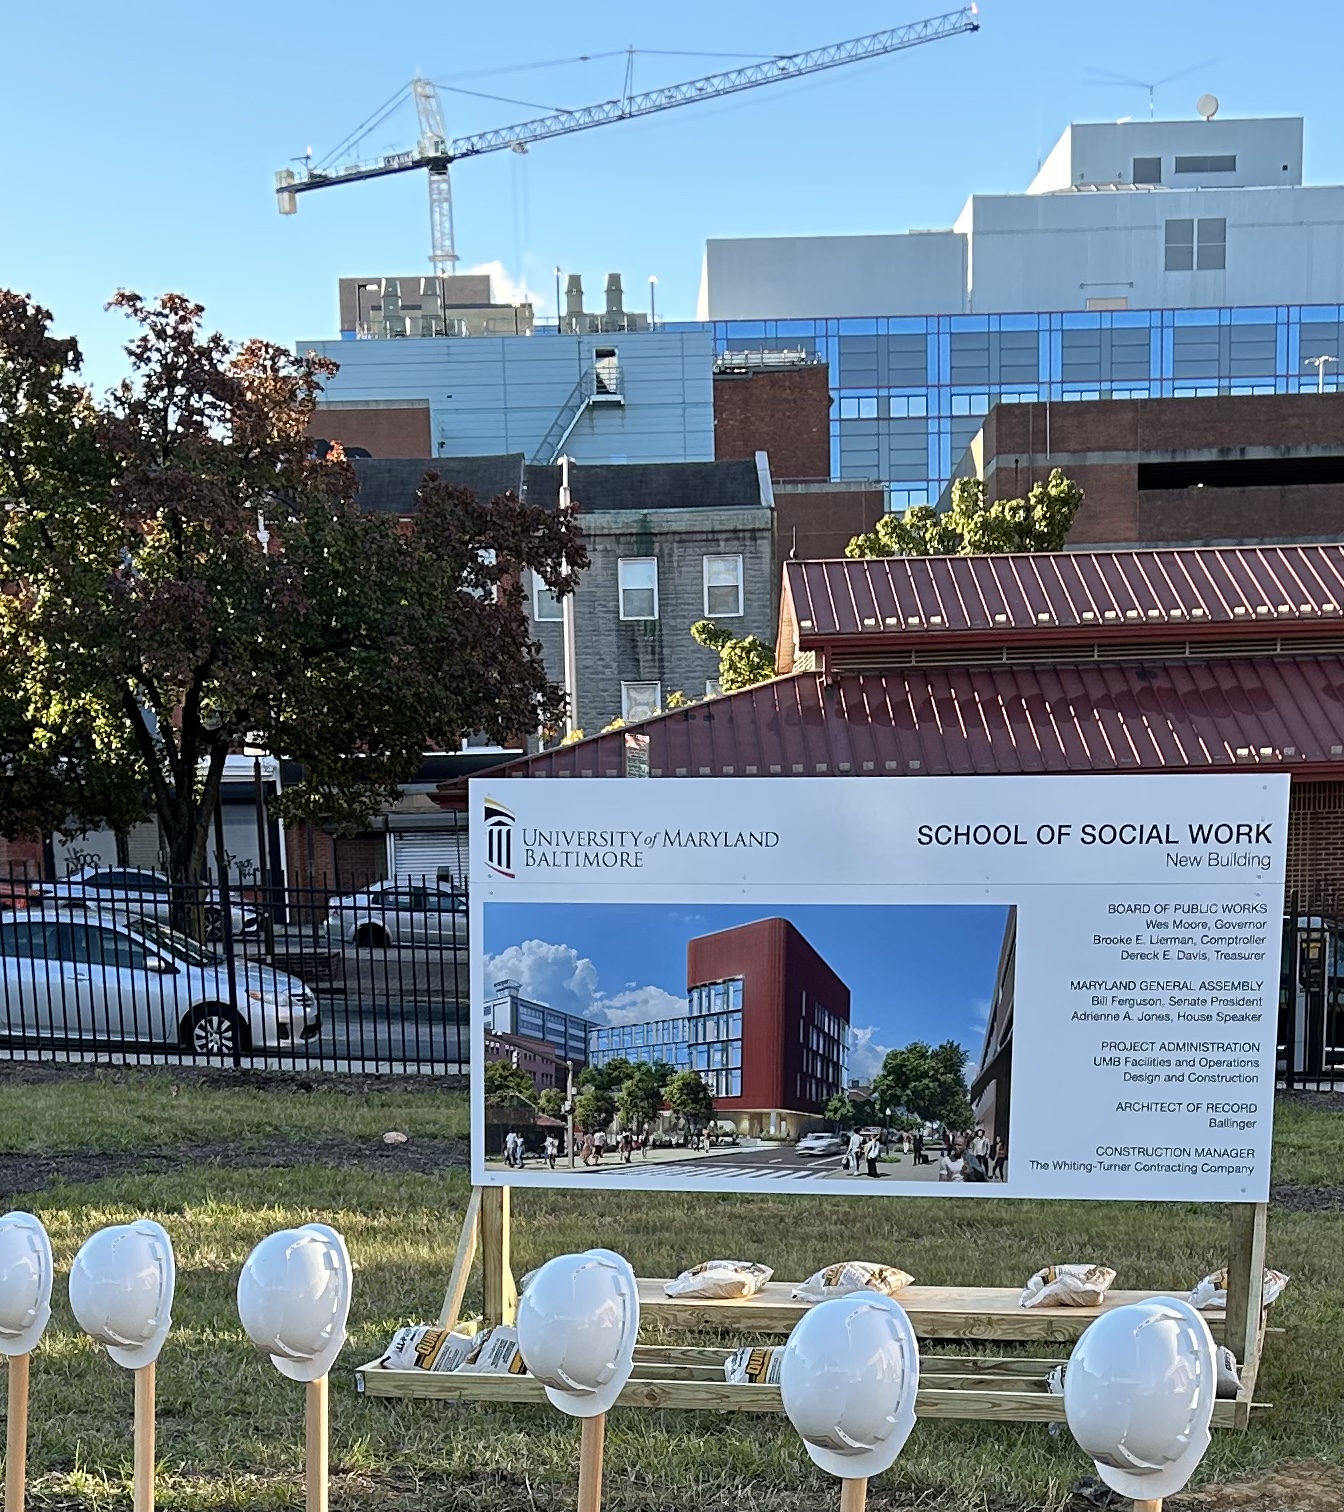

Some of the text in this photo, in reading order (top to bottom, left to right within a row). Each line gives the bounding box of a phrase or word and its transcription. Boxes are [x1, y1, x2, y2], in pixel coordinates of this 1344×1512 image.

[522, 828, 779, 849] UNIVERSITY of MARYLAND
[918, 824, 1272, 845] SCHOOL OF SOCIAL WORK
[526, 849, 643, 867] BALTIMORE
[1166, 852, 1271, 870] New Building
[1108, 903, 1267, 914] BOARD OF PUBLIC WORKS
[1146, 919, 1267, 931] Wes Moore, Governor
[1093, 934, 1266, 947] Brooke E. Lierman, Comptroller
[1121, 950, 1266, 962] Dereck E. Davis, Treasurer
[1071, 981, 1264, 991] MARYLAND GENERAL ASSEMBLY
[1092, 996, 1263, 1008] Bill Ferguson, Senate President
[1071, 1011, 1262, 1024] Adrienne A. Jones, House Speaker
[1101, 1041, 1260, 1052] PROJECT ADMINISTRATION
[1094, 1056, 1259, 1069] UMB Facilities and Operations
[1124, 1072, 1258, 1084] Design and Construction
[1116, 1102, 1257, 1113] ARCHITECT OF RECORD
[1209, 1118, 1257, 1130] Ballinger
[1096, 1146, 1255, 1158] CONSTRUCTION MANAGER
[1029, 1160, 1254, 1176] The Whiting-Turner Contracting Company
